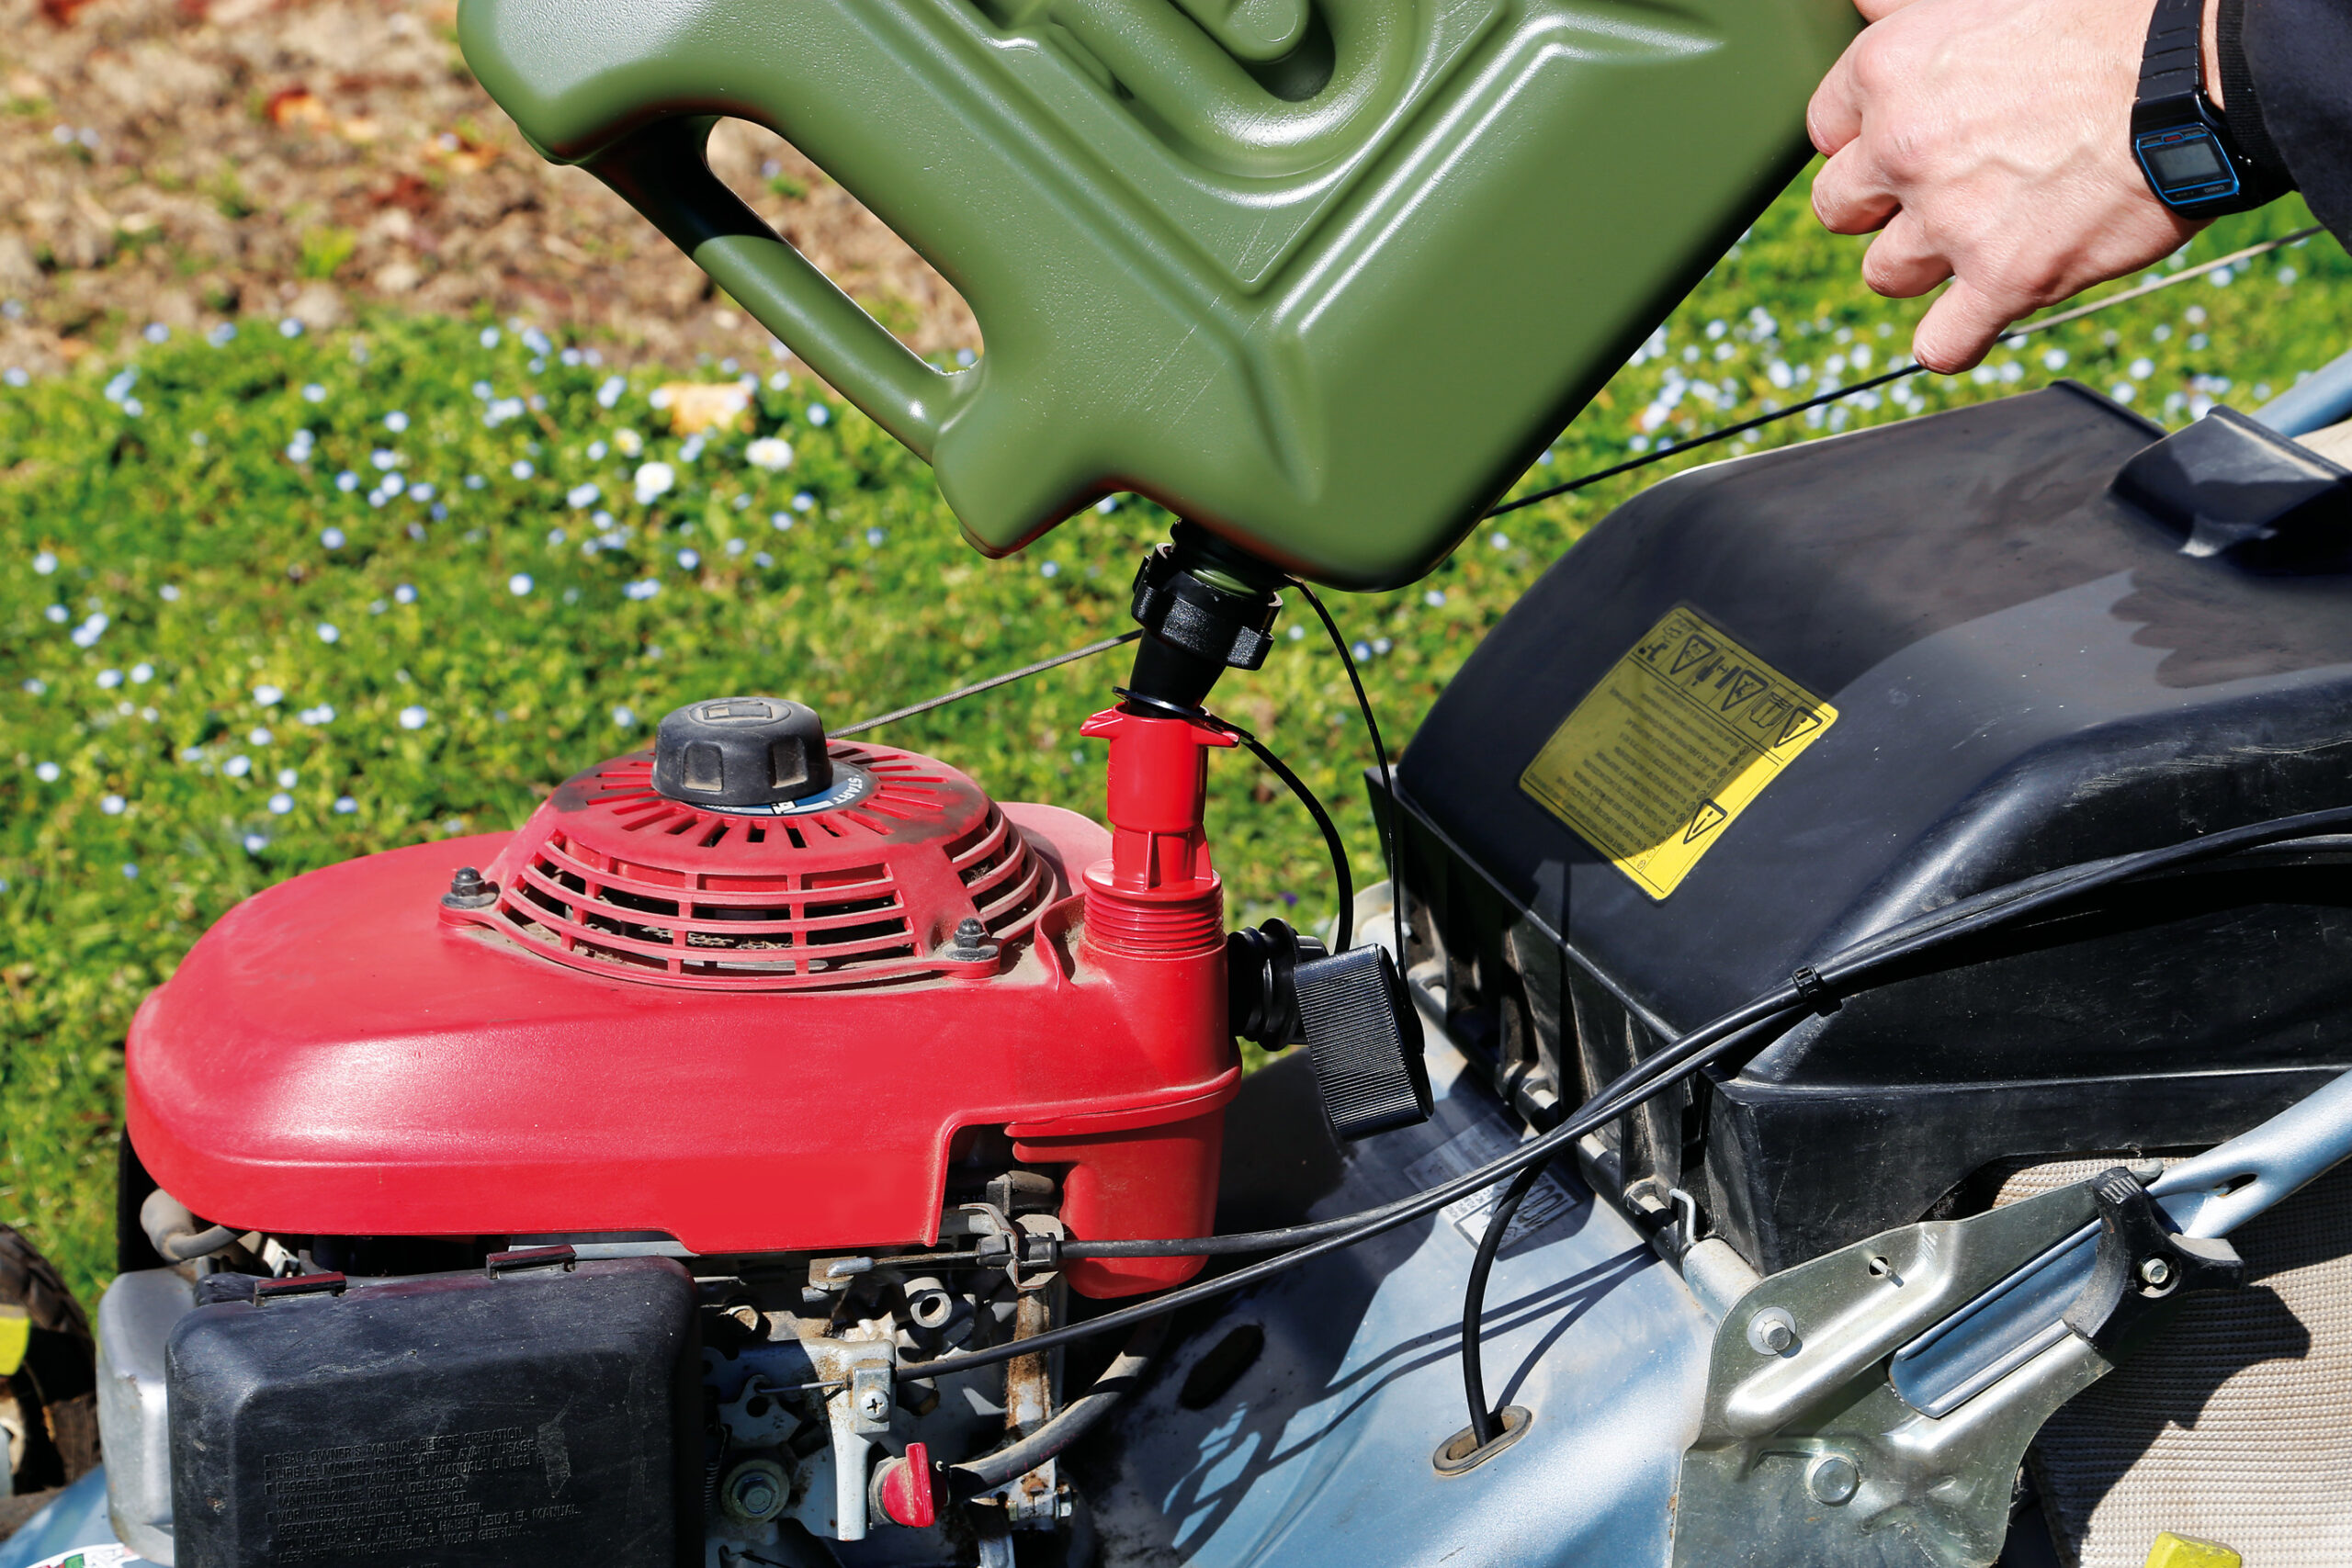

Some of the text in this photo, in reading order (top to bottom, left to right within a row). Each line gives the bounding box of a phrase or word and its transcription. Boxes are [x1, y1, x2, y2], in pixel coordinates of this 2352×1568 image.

[833, 777, 863, 805] START
[275, 1452, 304, 1466] READ
[419, 1435, 459, 1451] BEFORE
